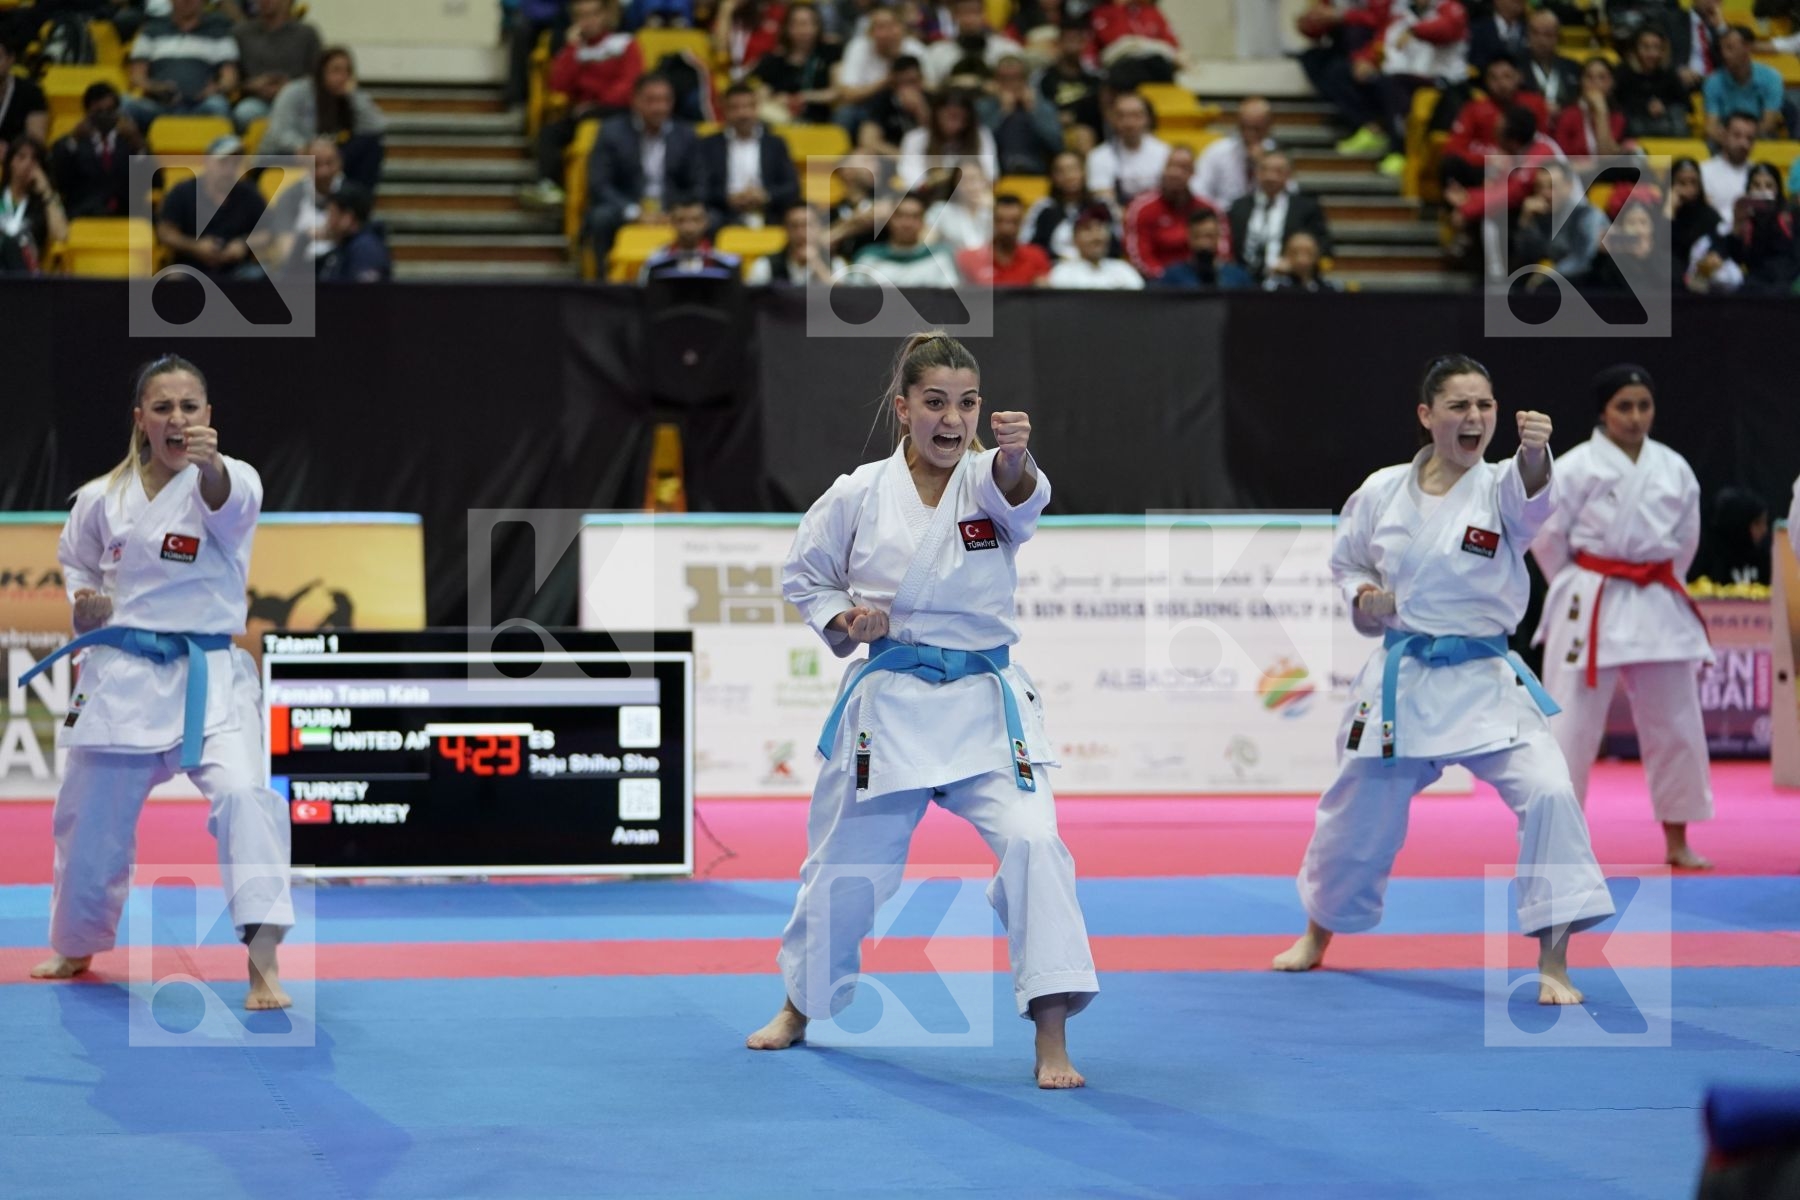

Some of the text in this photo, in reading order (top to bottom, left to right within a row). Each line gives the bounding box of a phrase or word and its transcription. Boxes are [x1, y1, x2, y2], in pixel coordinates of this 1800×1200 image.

[264, 634, 339, 653] Tatami 1
[271, 685, 430, 704] Female Team Kata
[291, 708, 351, 728] DUBAI
[333, 731, 403, 750] UNITED
[438, 735, 521, 776] 4:23
[622, 753, 660, 773] Sho
[291, 781, 369, 801] TURKEY
[333, 804, 410, 823] TURKEY
[611, 826, 660, 845] Anan
